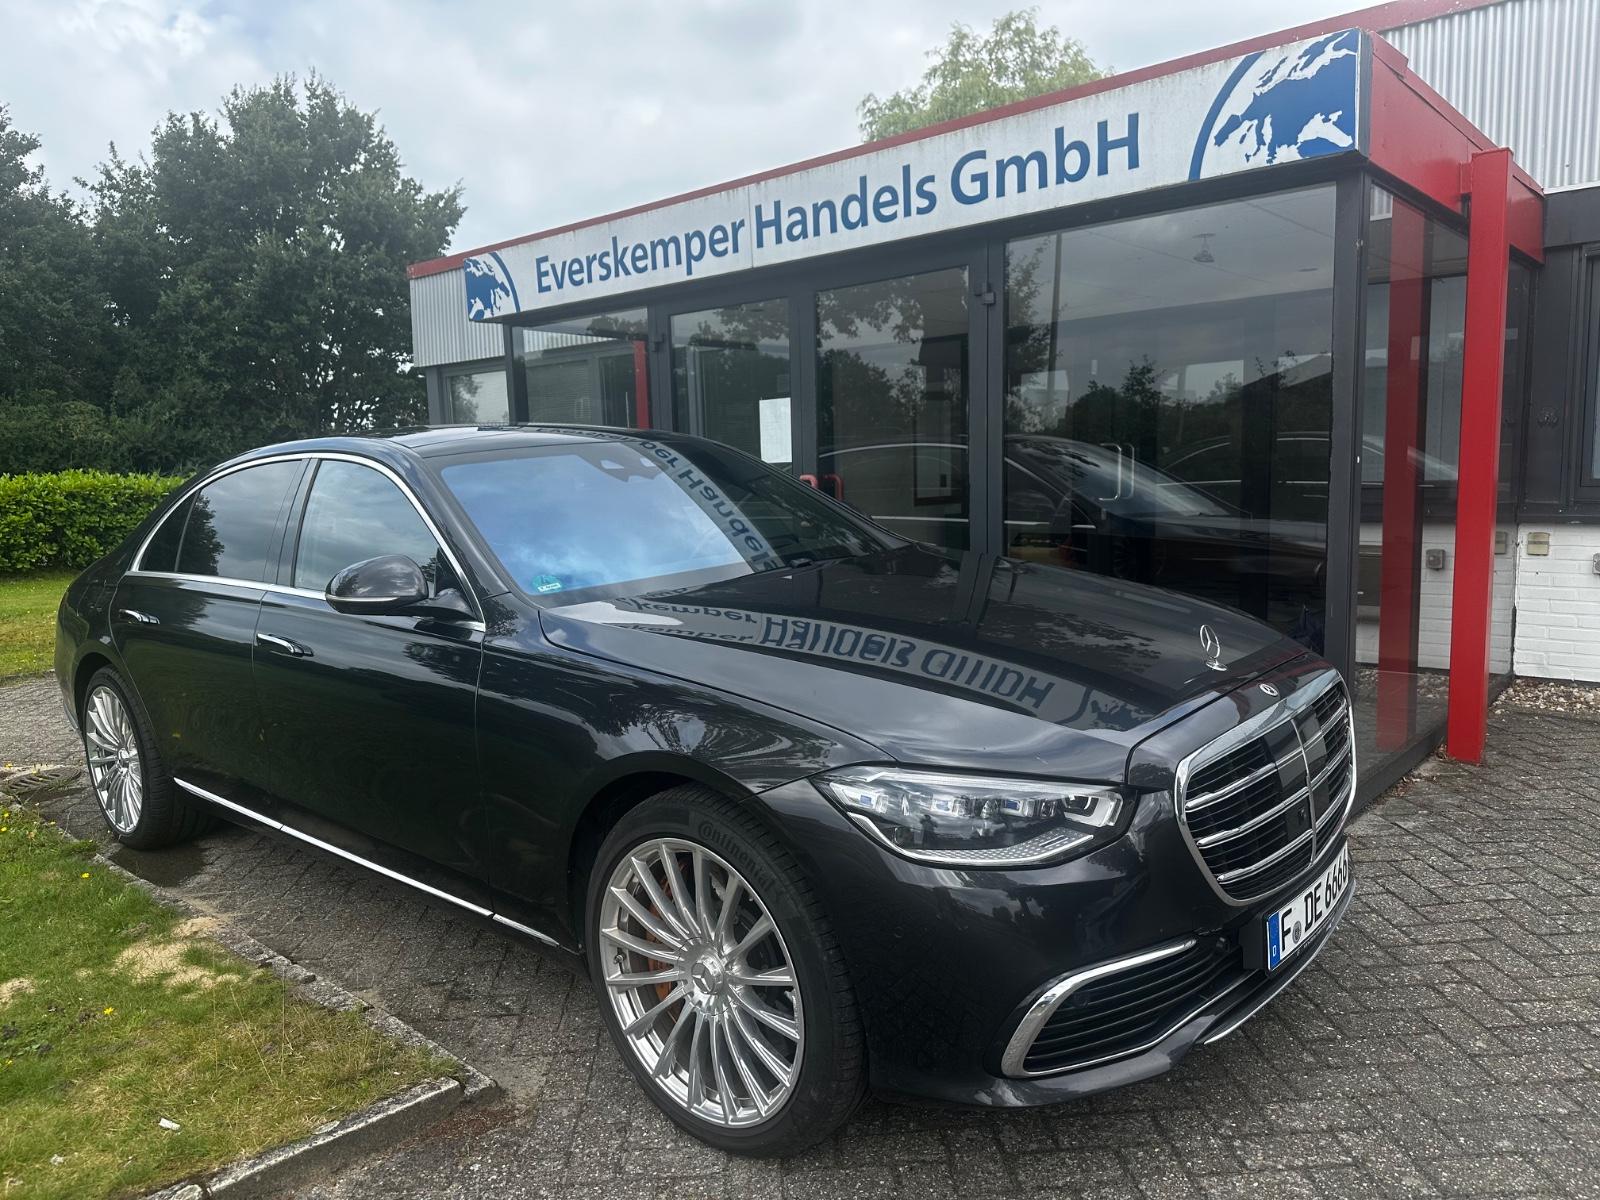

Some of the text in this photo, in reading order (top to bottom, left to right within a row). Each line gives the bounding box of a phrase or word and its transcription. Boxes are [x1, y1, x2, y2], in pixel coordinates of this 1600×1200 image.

[536, 113, 1140, 294] Everskemper Handels GmbH
[1281, 908, 1292, 952] F
[1304, 882, 1322, 932] DE
